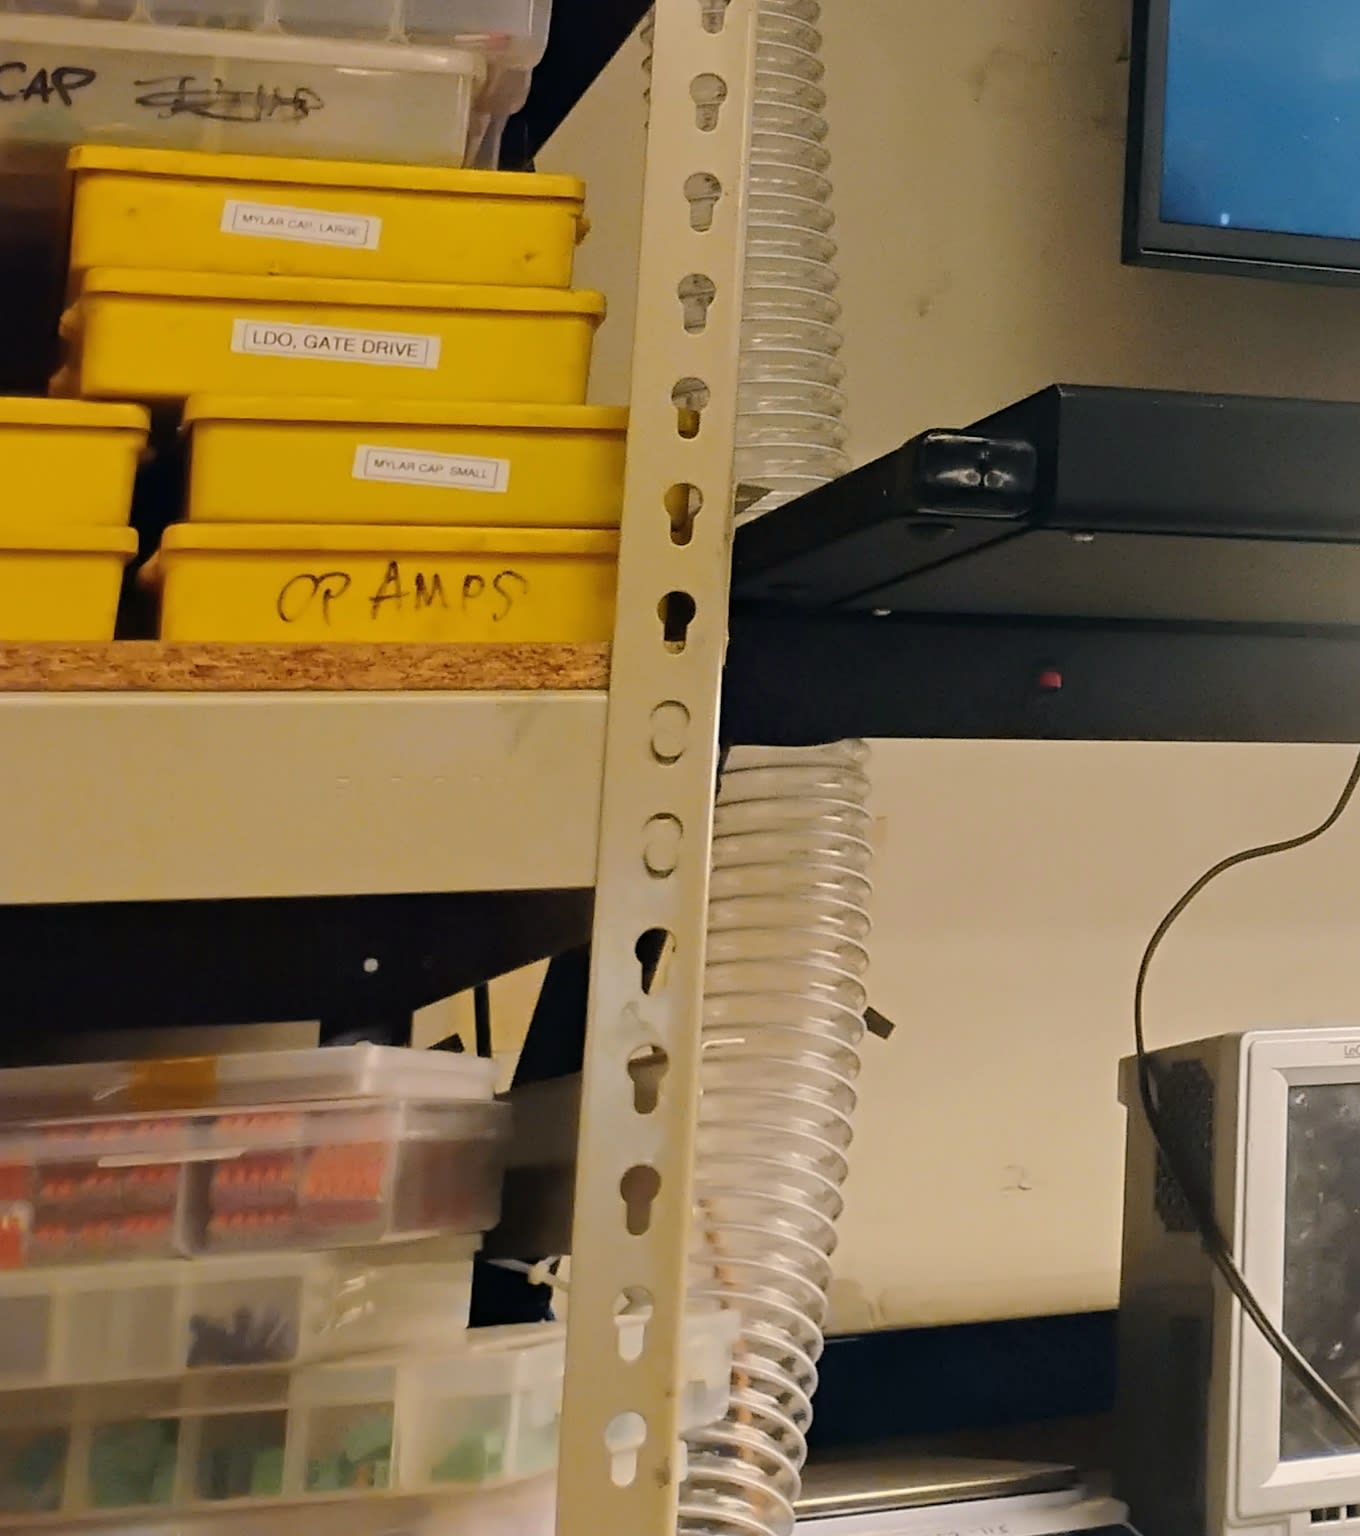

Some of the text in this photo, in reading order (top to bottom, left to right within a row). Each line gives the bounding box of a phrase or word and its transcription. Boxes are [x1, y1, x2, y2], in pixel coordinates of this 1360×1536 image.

[0, 61, 97, 107] CAP
[242, 213, 284, 226] MYLAR
[252, 329, 418, 358] LDO, GATE DRIVE
[373, 458, 415, 472] MYLAR
[277, 560, 529, 626] OP AMPS
